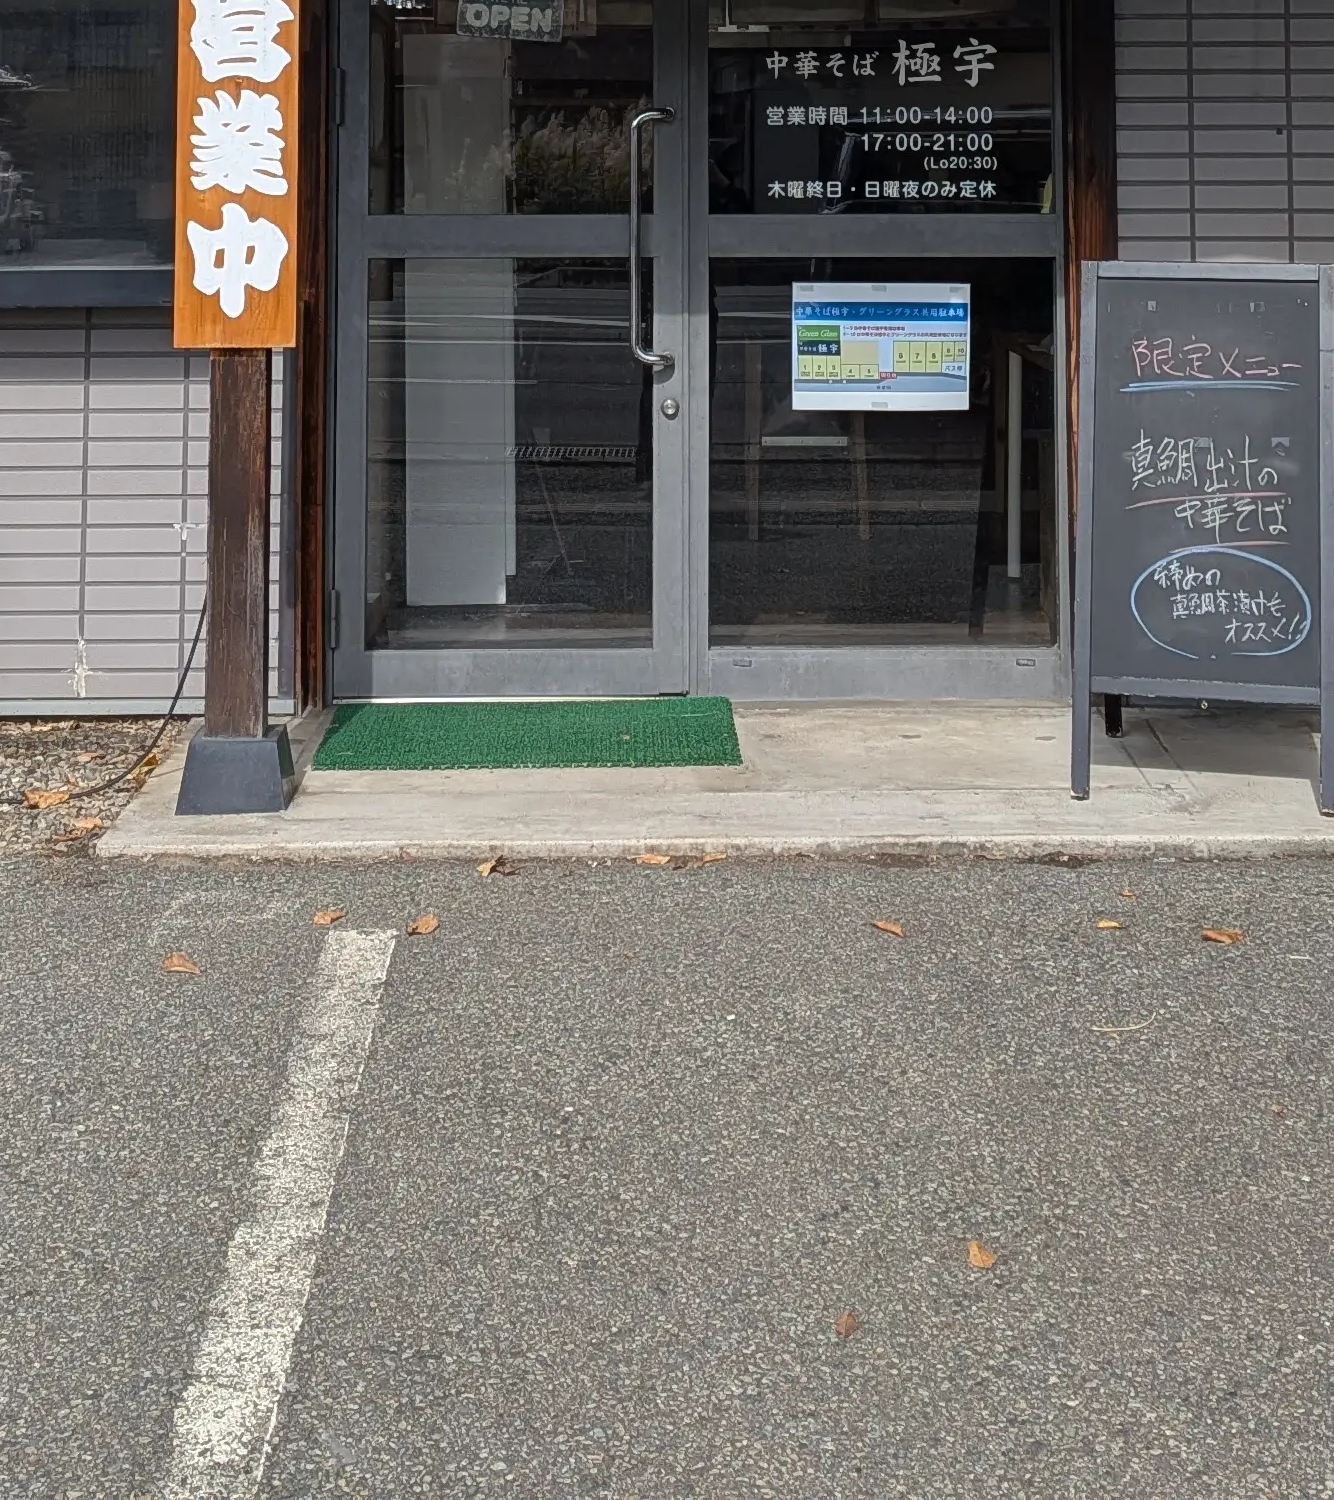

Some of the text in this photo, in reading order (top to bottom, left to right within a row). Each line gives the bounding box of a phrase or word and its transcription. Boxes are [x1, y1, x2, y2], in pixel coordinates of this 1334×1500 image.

[466, 3, 553, 33] OPEN
[765, 37, 998, 87] 中華そば 極宇
[766, 106, 993, 126] 営業時間 11:00-14:00
[860, 133, 993, 152] 17:00-21:00
[923, 156, 998, 171] (Lo20:30)
[767, 180, 997, 199] 木曜終日・日曜夜のみ定休
[1131, 333, 1304, 379] 限定メニュー
[1174, 496, 1292, 544] 中華そば
